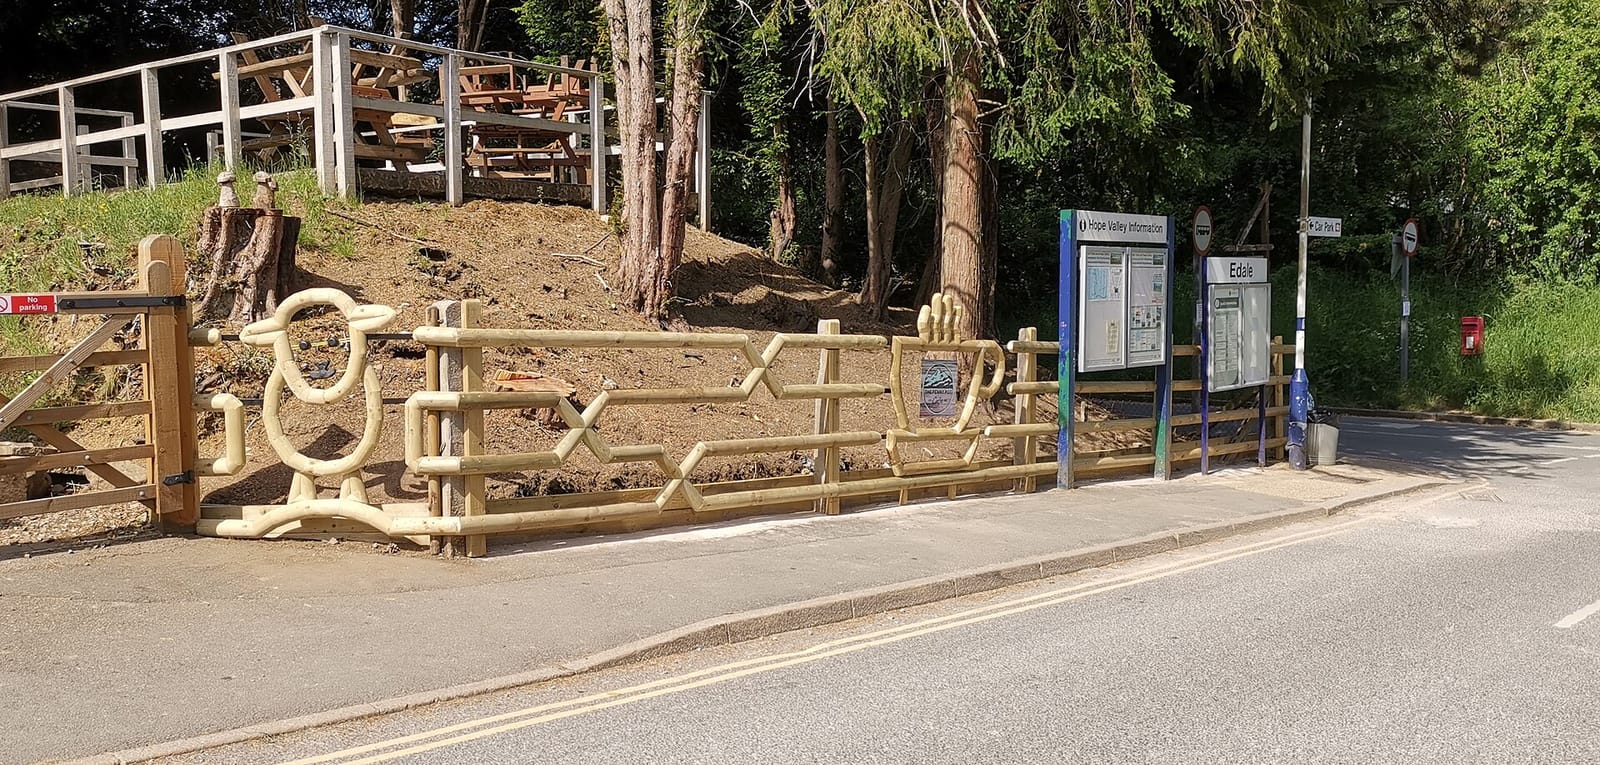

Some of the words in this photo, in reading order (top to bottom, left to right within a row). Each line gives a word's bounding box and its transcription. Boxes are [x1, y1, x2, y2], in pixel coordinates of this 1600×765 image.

[1088, 219, 1106, 232] Hope
[1108, 220, 1127, 233] Valley
[1129, 221, 1163, 233] Information
[1315, 221, 1323, 232] Car
[1324, 221, 1334, 232] Park
[1230, 262, 1253, 278] Edale
[19, 304, 48, 312] parking
